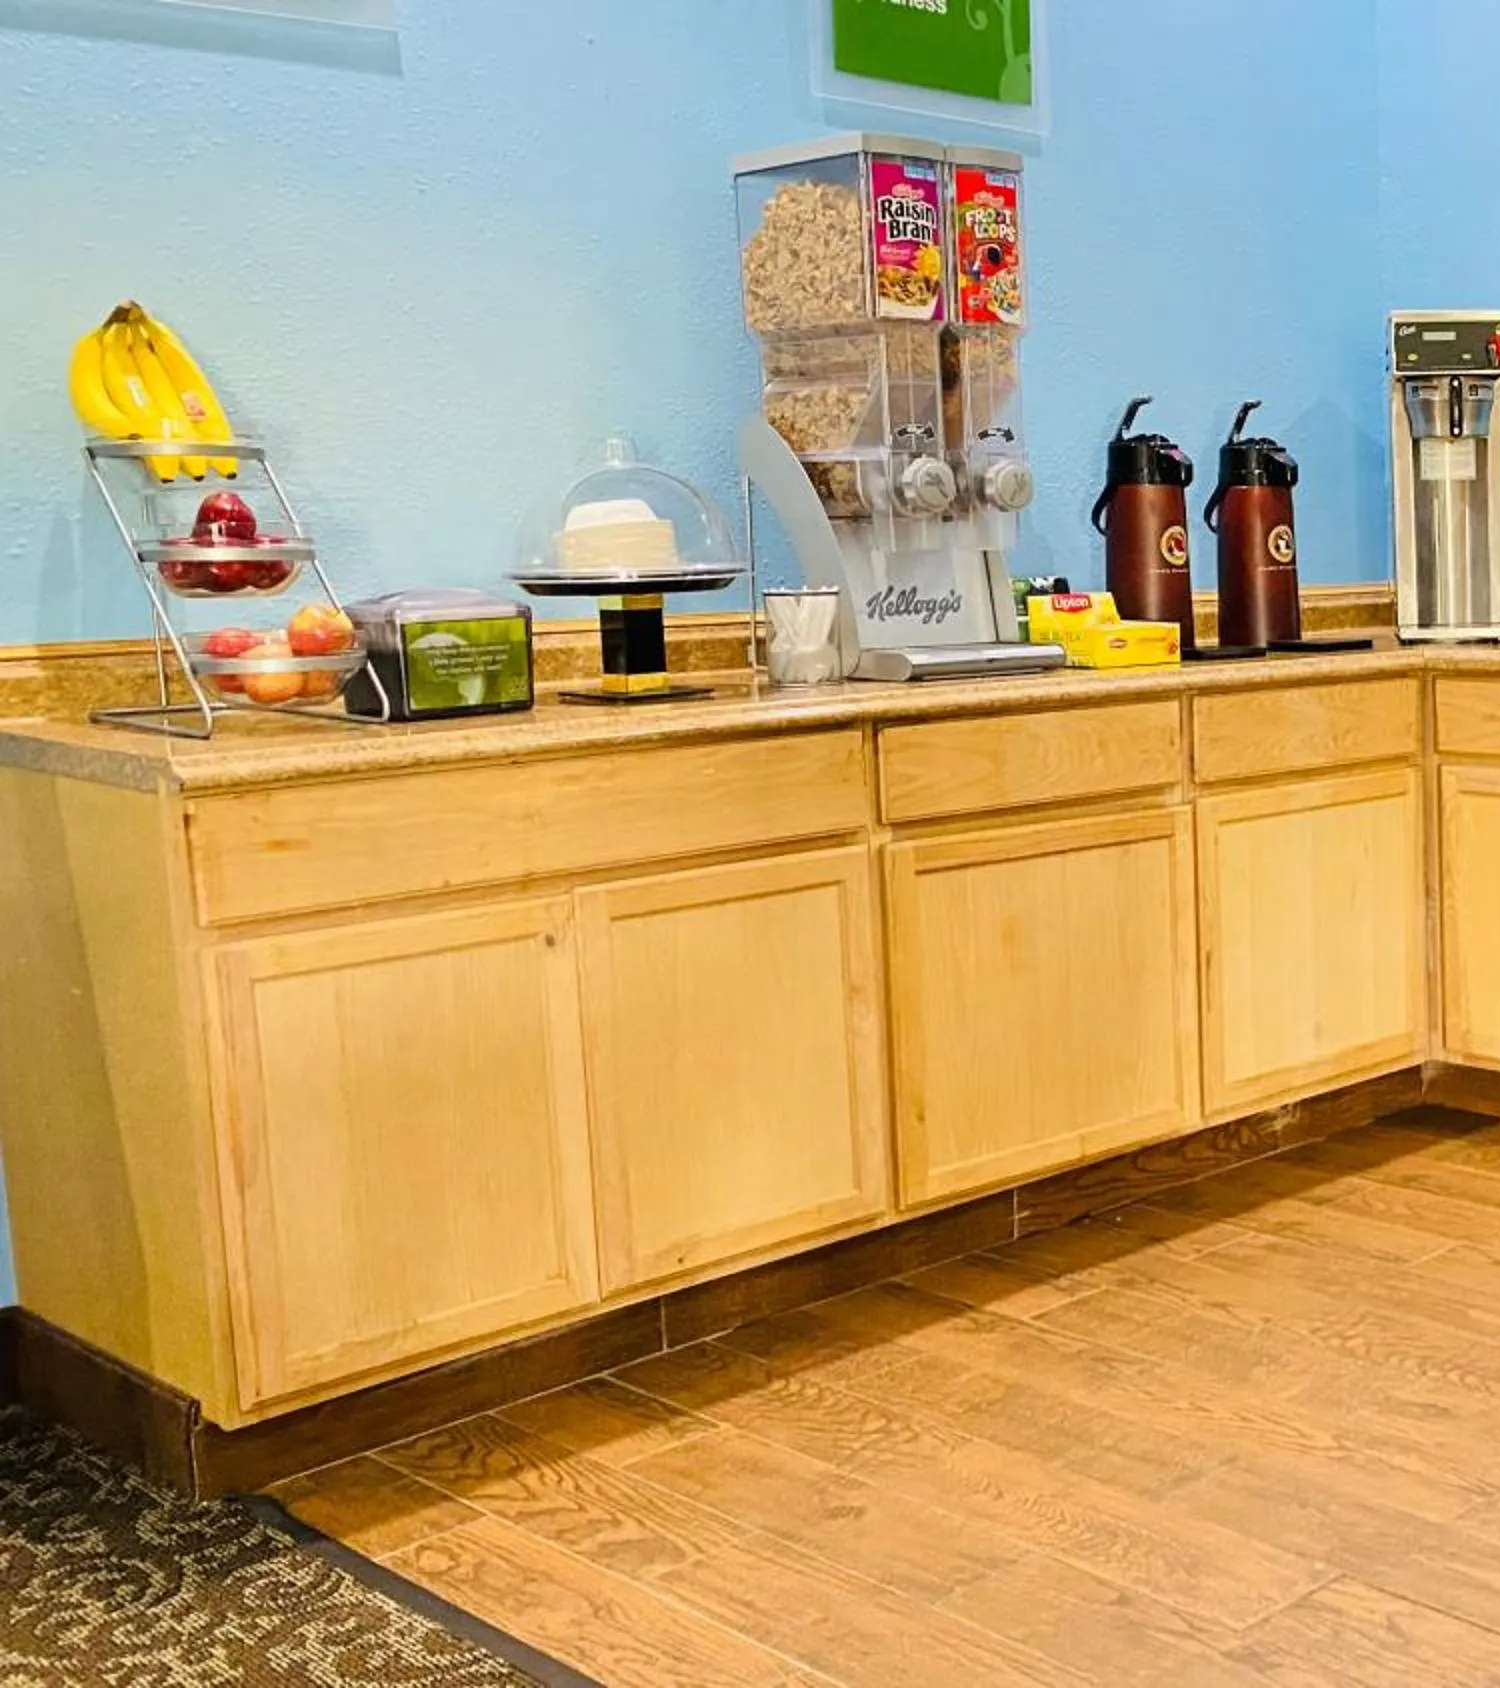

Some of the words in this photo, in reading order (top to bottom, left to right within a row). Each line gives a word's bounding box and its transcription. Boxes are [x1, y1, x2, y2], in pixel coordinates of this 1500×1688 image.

[878, 196, 935, 226] Raisin
[888, 219, 932, 242] Bran
[974, 223, 1016, 243] LOOPS
[866, 585, 963, 624] Kellogg's
[1055, 597, 1089, 612] Lipton
